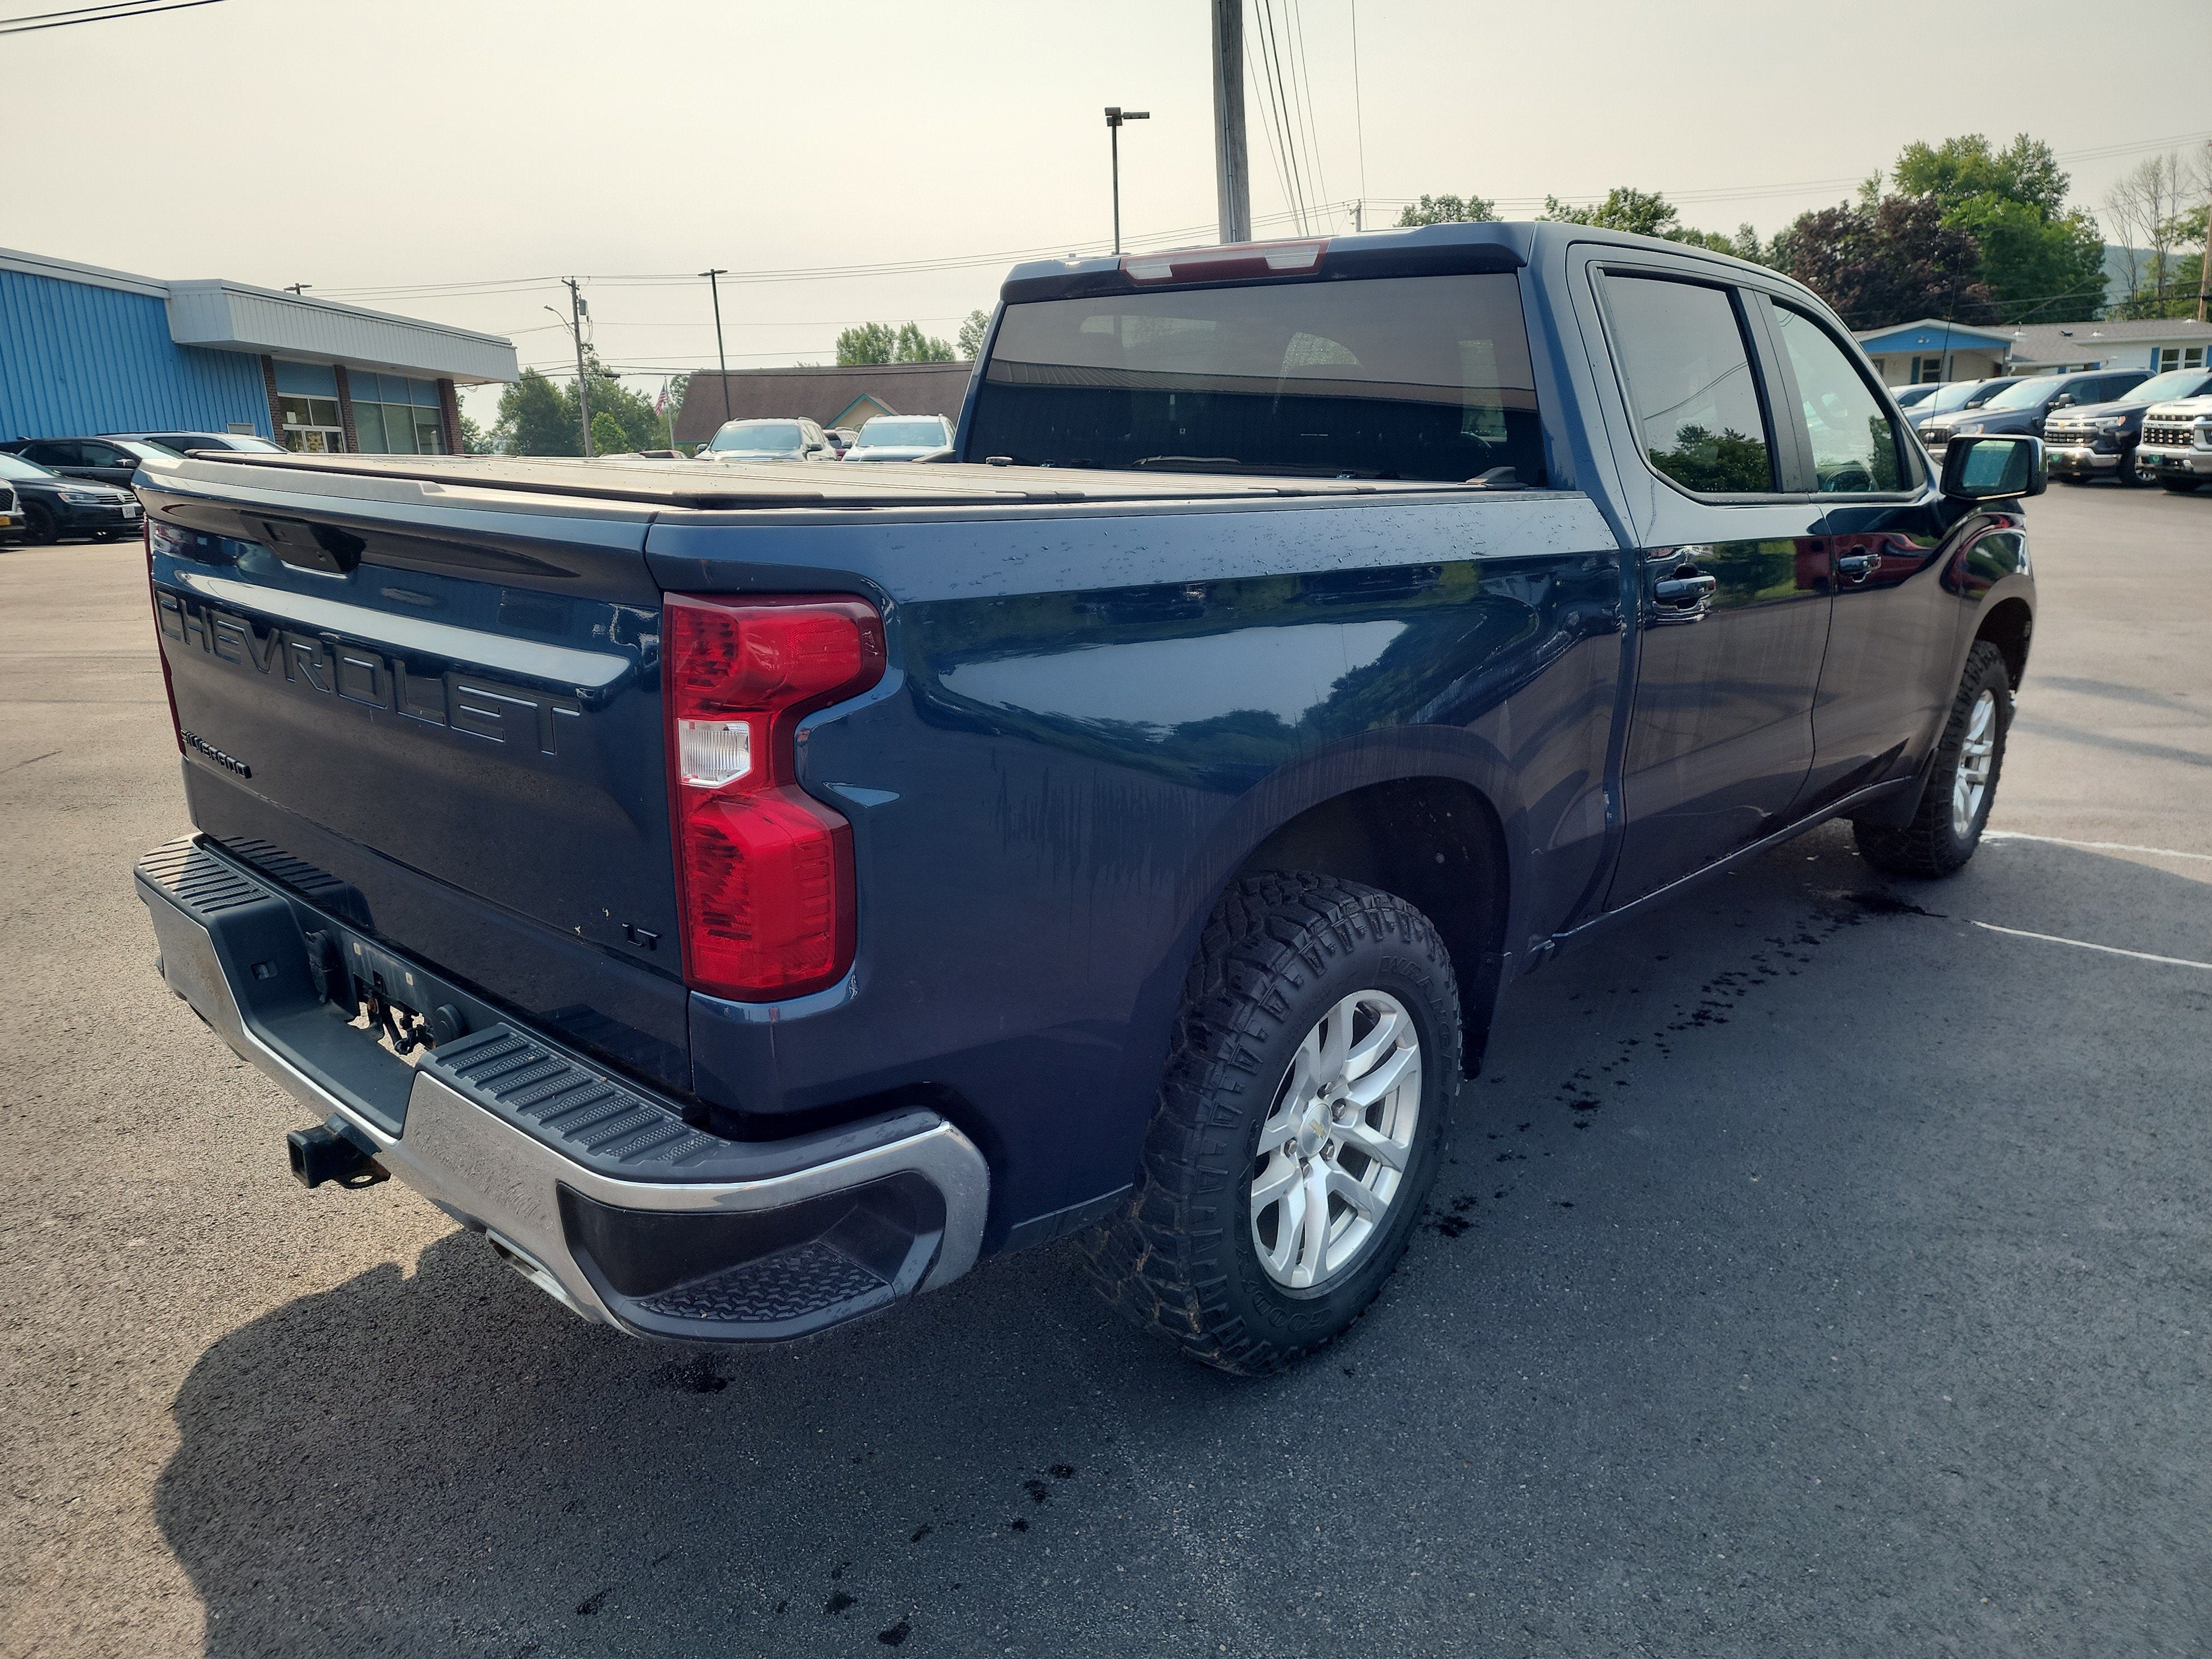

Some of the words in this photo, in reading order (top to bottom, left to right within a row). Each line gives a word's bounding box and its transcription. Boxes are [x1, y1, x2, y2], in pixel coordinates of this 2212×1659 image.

[156, 590, 581, 756] CHEVROLET
[180, 727, 252, 779] SILVERADO
[622, 923, 662, 951] LT
[1381, 954, 1452, 1155] WRANGL
